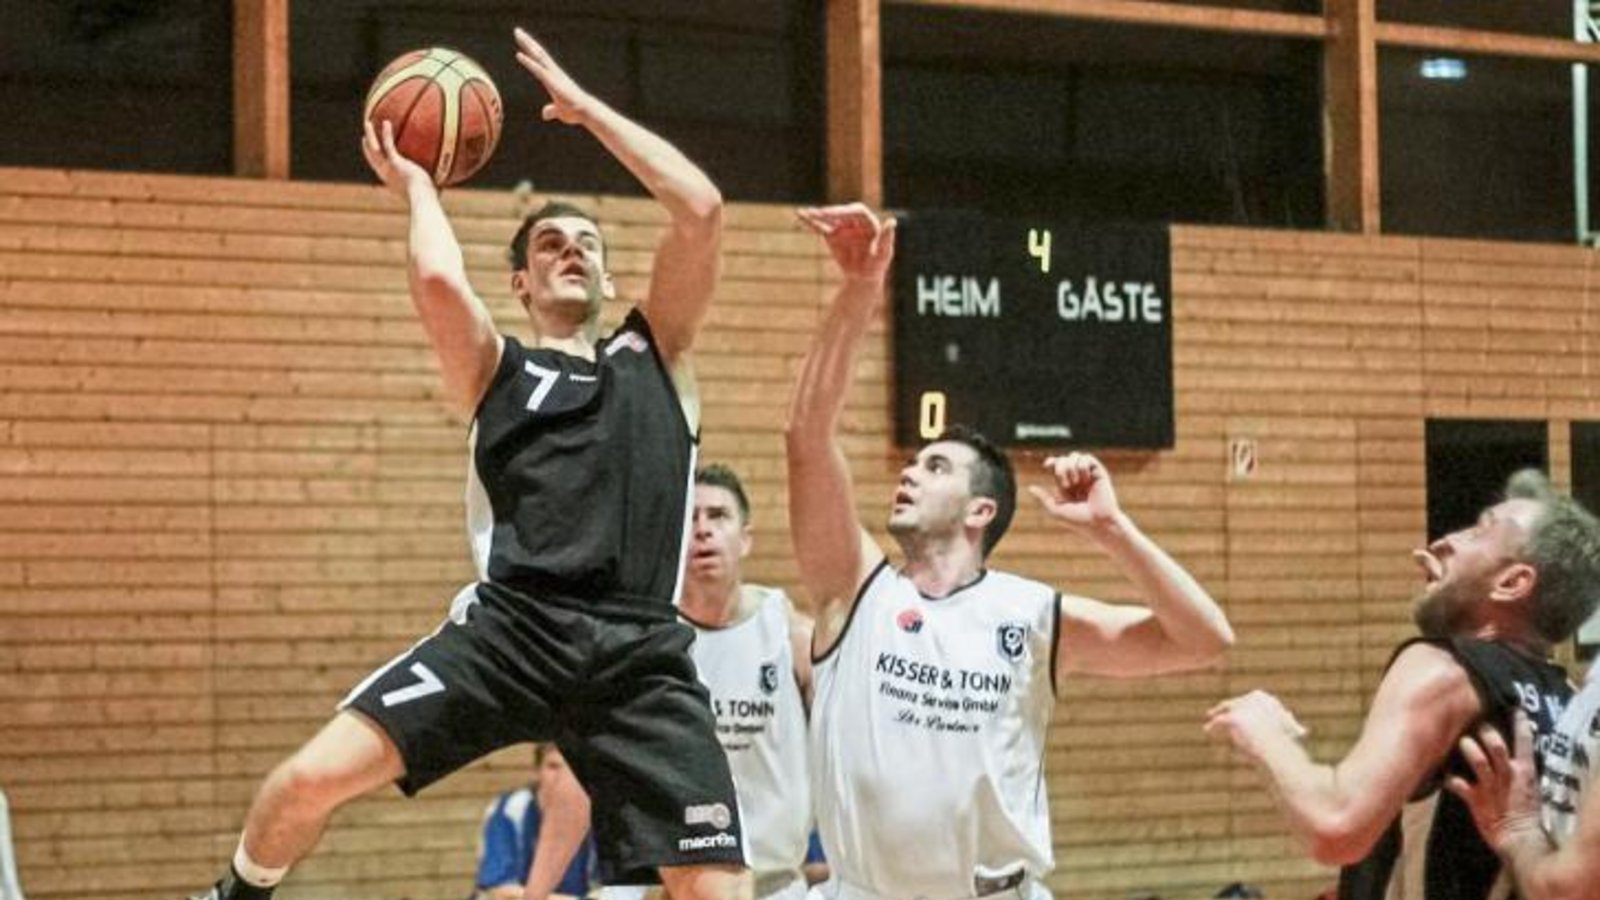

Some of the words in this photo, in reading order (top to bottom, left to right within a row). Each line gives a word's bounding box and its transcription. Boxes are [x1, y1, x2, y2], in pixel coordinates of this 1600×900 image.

[1027, 228, 1052, 273] 4
[917, 275, 1000, 318] HEIM
[524, 359, 561, 412] 7
[920, 391, 946, 439] 0
[381, 661, 446, 707] 7
[876, 652, 939, 686] KISSER
[941, 670, 953, 690] &
[728, 699, 775, 718] TONN
